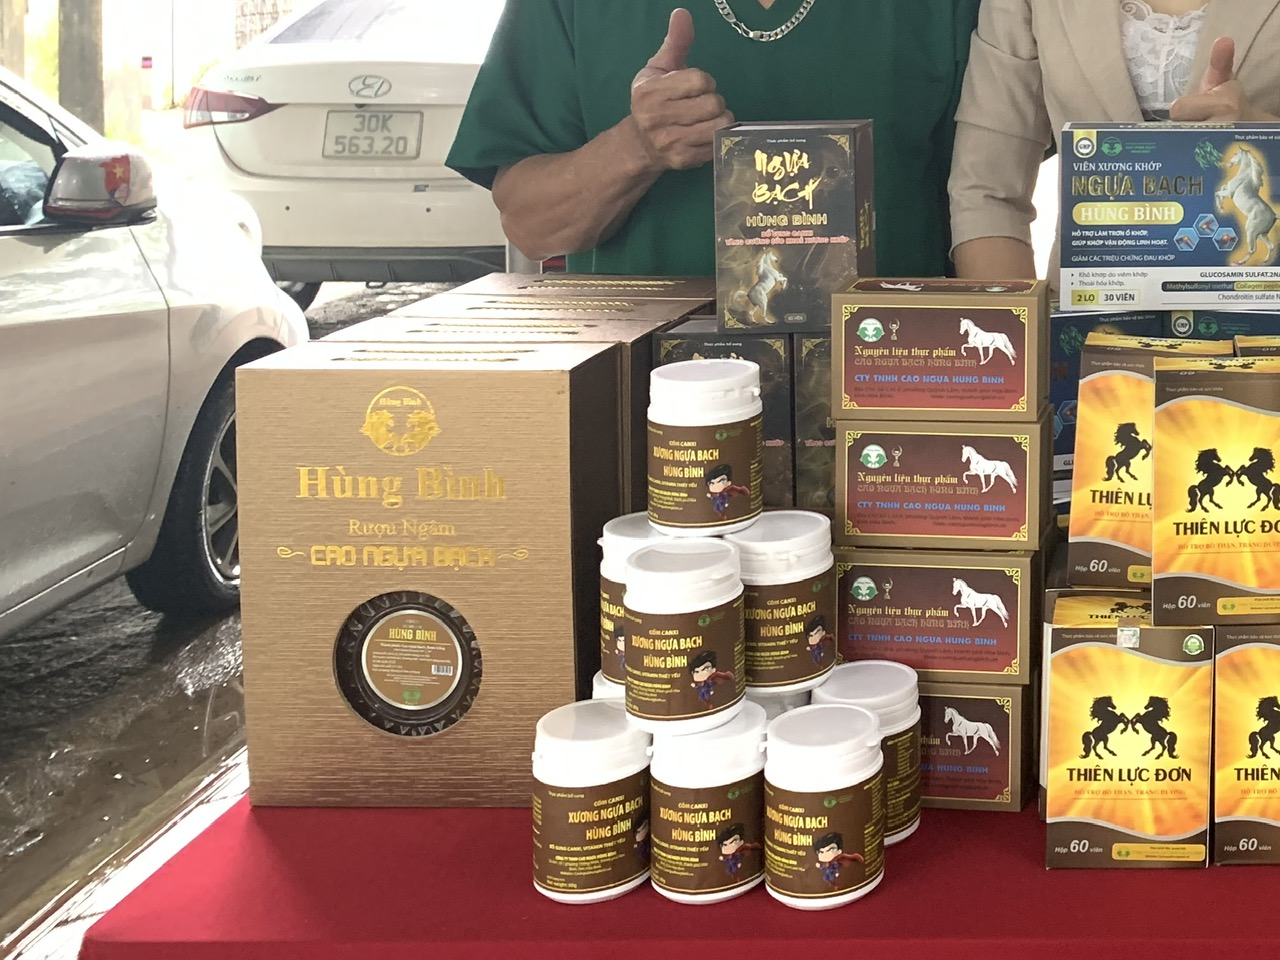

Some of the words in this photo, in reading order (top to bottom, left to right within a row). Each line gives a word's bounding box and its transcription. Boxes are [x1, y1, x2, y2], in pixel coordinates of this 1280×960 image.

[353, 114, 393, 133] 30K
[334, 136, 408, 155] 563.20
[1073, 161, 1096, 171] VIÊN
[1097, 161, 1133, 171] XƯƠNG
[1135, 161, 1162, 171] KHỚP
[1072, 173, 1135, 200] NGỰA
[746, 213, 788, 227] HÙNG
[792, 212, 828, 225] BÌNH
[1081, 203, 1129, 221] HÙNG
[1134, 203, 1176, 221] BÌNH
[1084, 294, 1095, 303] LỌ
[1116, 292, 1135, 301] VIÊN
[873, 374, 898, 382] TNHH
[295, 465, 403, 508] Hùng
[416, 466, 507, 500] Bình
[1089, 487, 1134, 505] THIÊN
[348, 519, 396, 538] Rượu
[402, 518, 456, 538] Ngâm
[1173, 518, 1220, 536] THIÊN
[1224, 518, 1256, 538] LỰC
[310, 545, 357, 566] CAO
[362, 544, 427, 571] NGỰA
[433, 545, 496, 571] BẠCH
[1089, 559, 1108, 572] 60
[1162, 601, 1176, 610] Hộp
[1177, 595, 1197, 609] 60
[643, 653, 665, 668] HÙNG
[666, 654, 688, 668] BÌNH
[1066, 764, 1115, 782] THIÊN
[1118, 766, 1150, 786] LỰC
[1154, 765, 1192, 782] ĐƠN
[1233, 763, 1280, 781] THIÊN
[568, 808, 599, 824] XƯƠNG
[600, 805, 624, 822] NGỰA
[625, 795, 643, 814] BẠCH
[586, 825, 611, 840] HÙNG
[612, 819, 631, 836] BÌNH
[1054, 844, 1068, 854] Hộp
[1069, 839, 1089, 853] 60
[1090, 845, 1103, 853] viên
[1224, 843, 1237, 852] Hộp
[1238, 838, 1257, 851] 60
